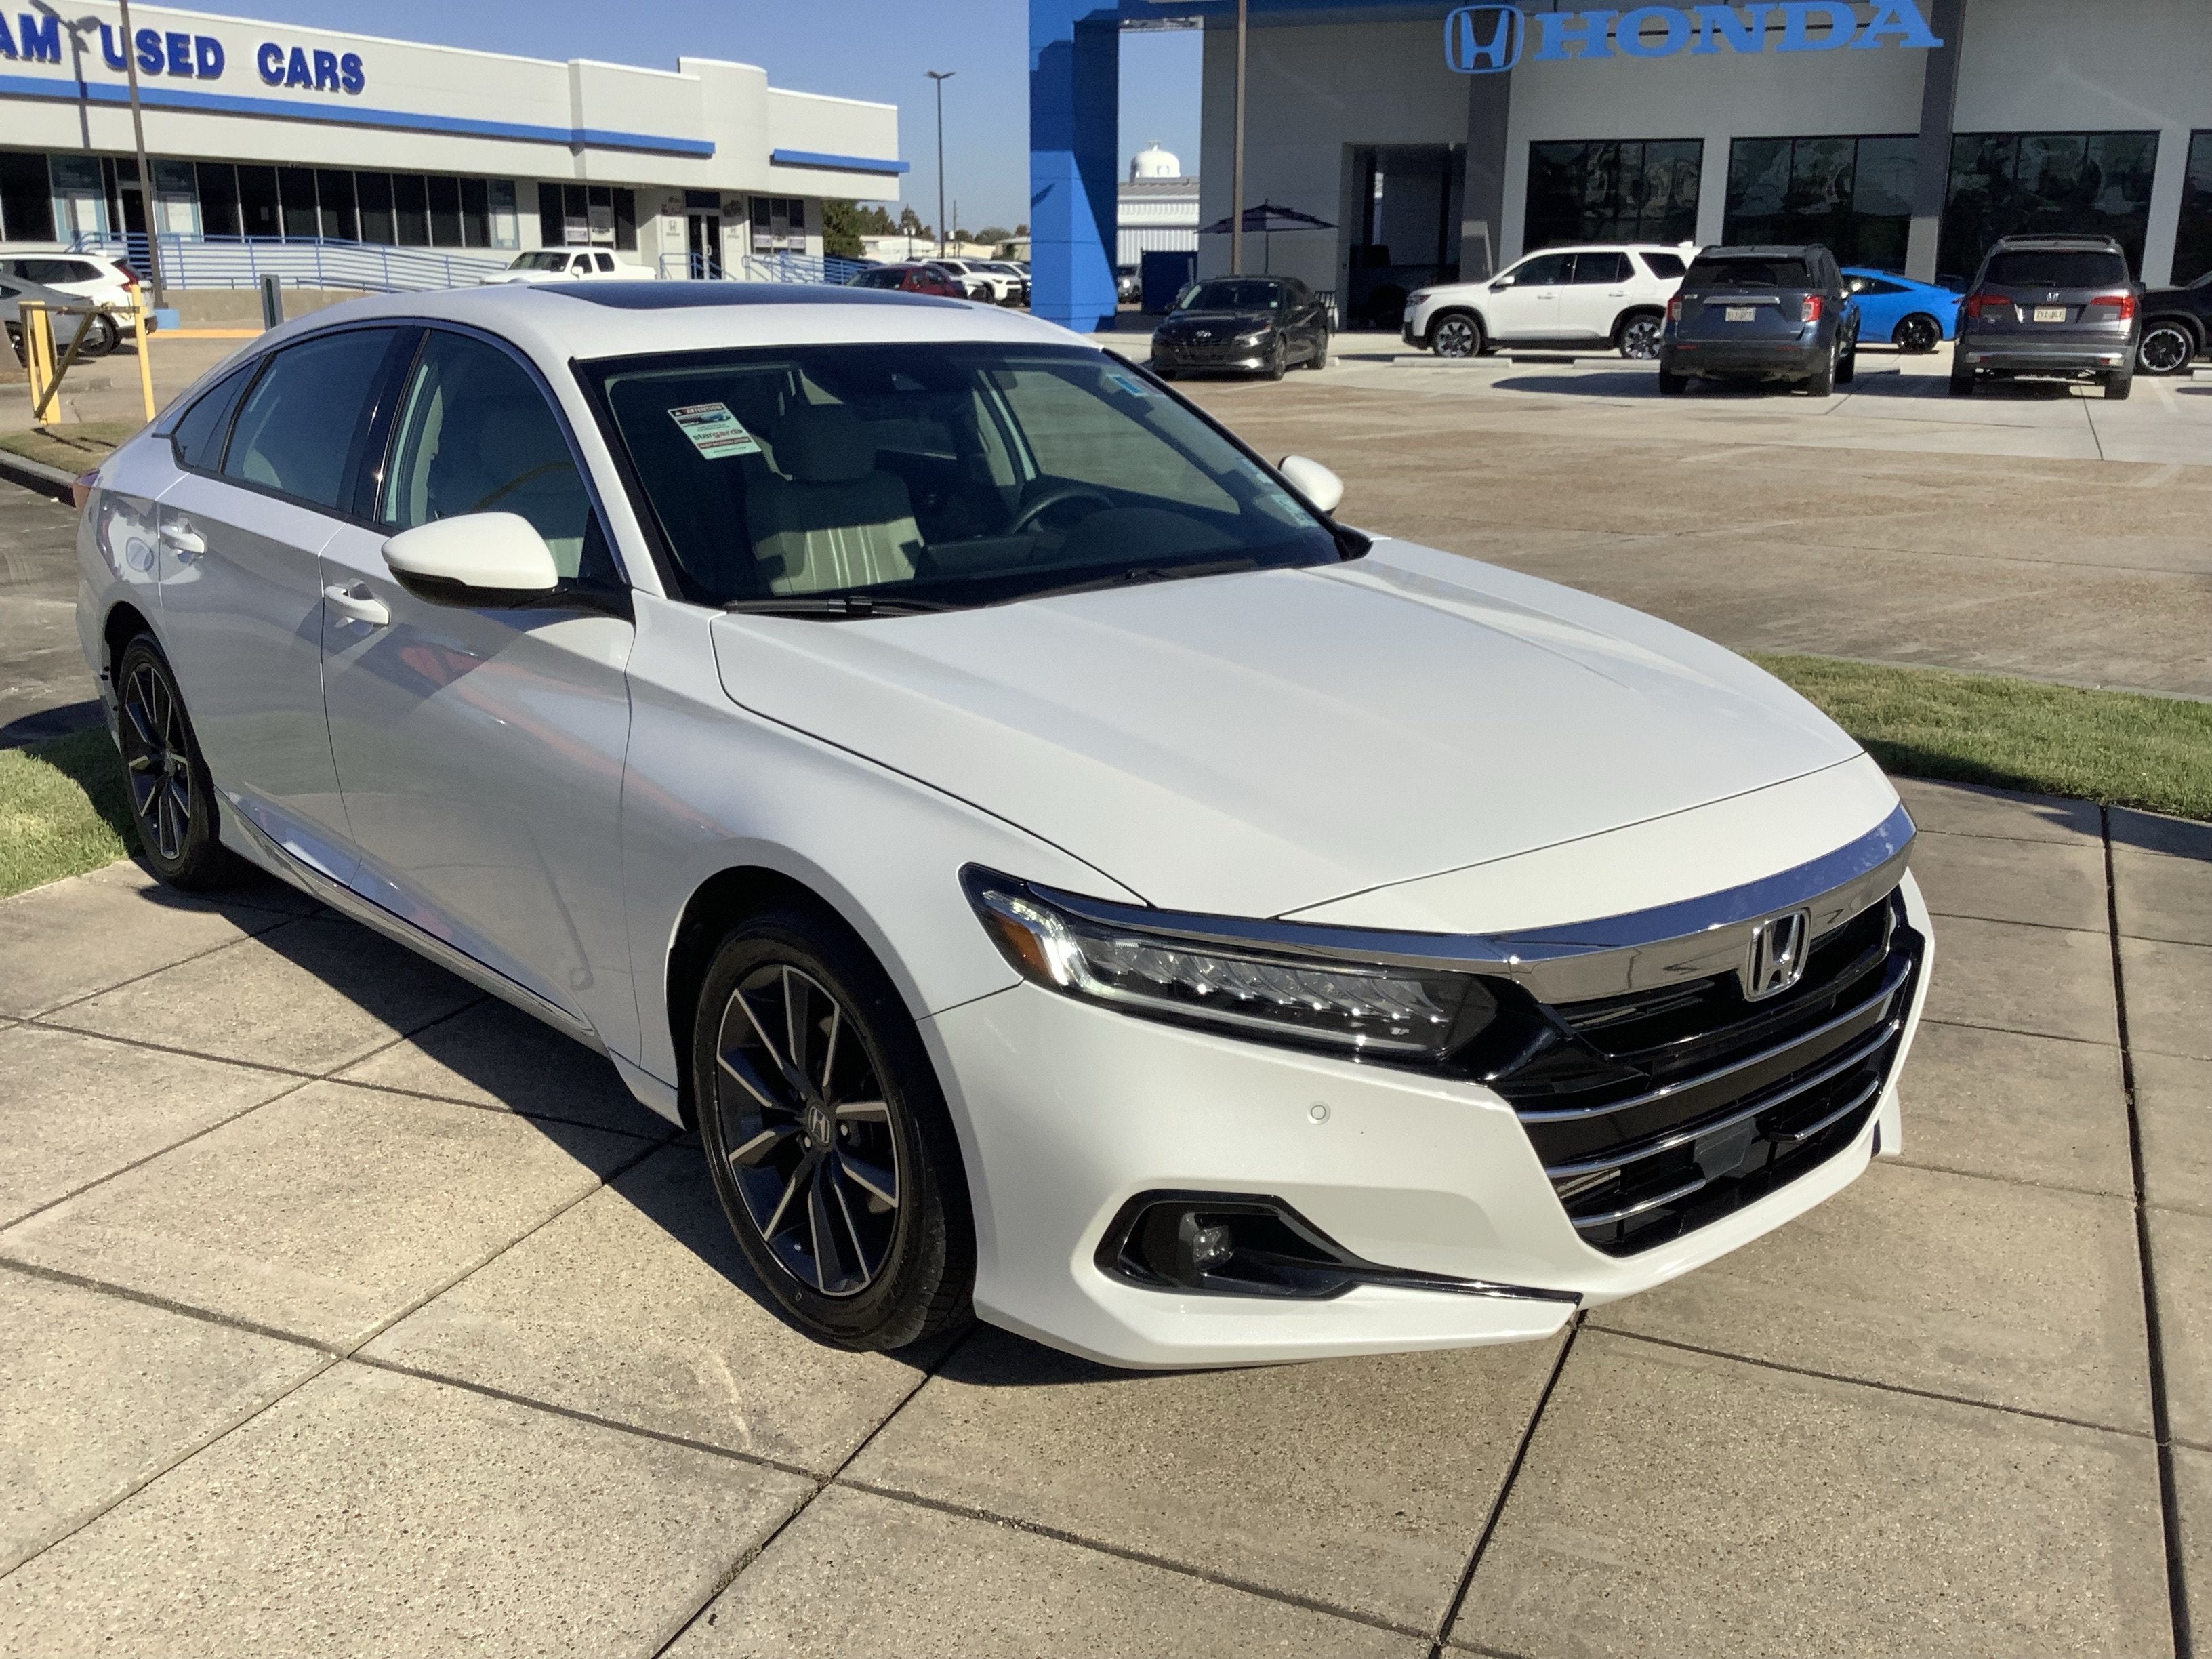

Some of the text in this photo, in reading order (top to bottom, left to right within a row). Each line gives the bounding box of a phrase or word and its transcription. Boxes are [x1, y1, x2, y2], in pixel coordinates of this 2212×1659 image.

[100, 24, 225, 79] USED
[257, 42, 365, 94] CARS
[1534, 0, 1944, 60] HONDA
